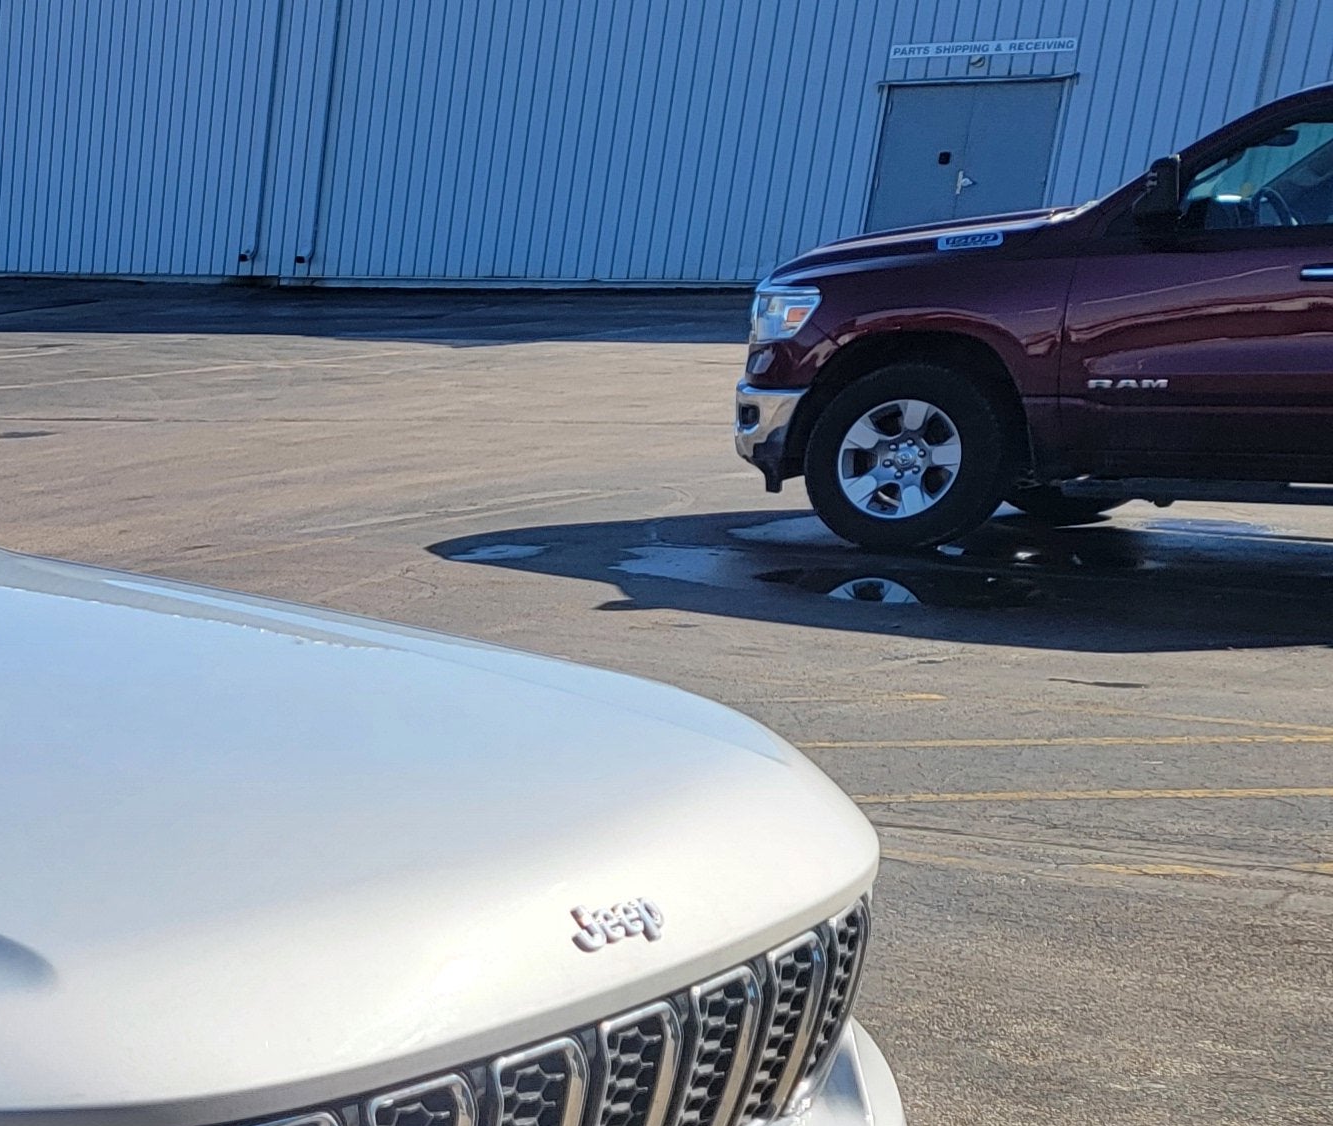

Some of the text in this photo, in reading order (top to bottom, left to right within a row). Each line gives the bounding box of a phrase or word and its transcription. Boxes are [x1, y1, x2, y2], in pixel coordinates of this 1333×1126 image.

[893, 40, 1075, 56] PARTS SHIPPING & RECEIVING
[1088, 379, 1169, 389] RAM
[570, 897, 665, 953] Jeep
